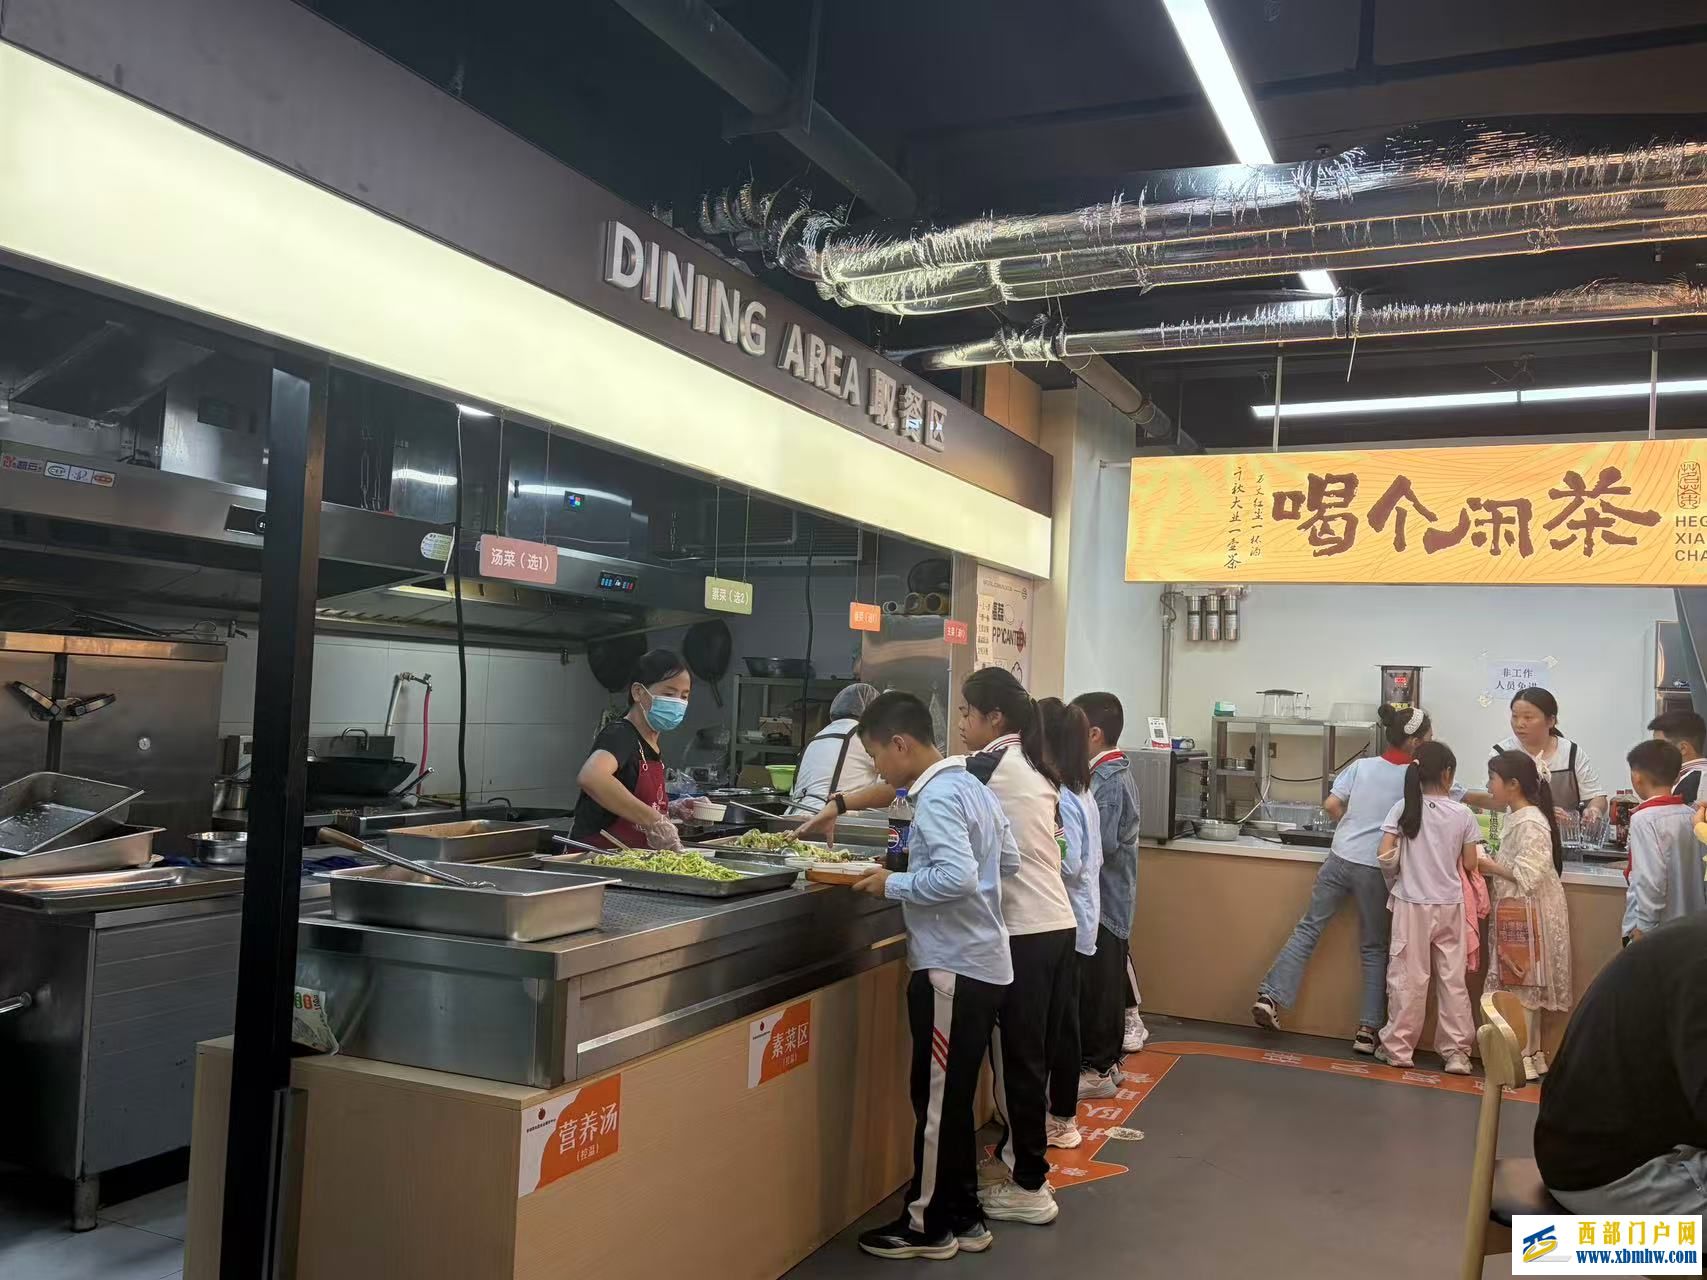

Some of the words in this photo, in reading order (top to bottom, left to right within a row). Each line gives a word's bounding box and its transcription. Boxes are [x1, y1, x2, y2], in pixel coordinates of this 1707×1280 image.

[604, 219, 768, 358] DINING
[776, 321, 861, 406] AREA
[867, 367, 948, 453] 取餐区
[1271, 466, 1663, 559] 喝个闲茶
[1675, 532, 1706, 545] XIA
[1502, 667, 1533, 679] 非工作
[771, 1021, 809, 1060] 素菜区
[559, 1102, 618, 1155] 营养汤
